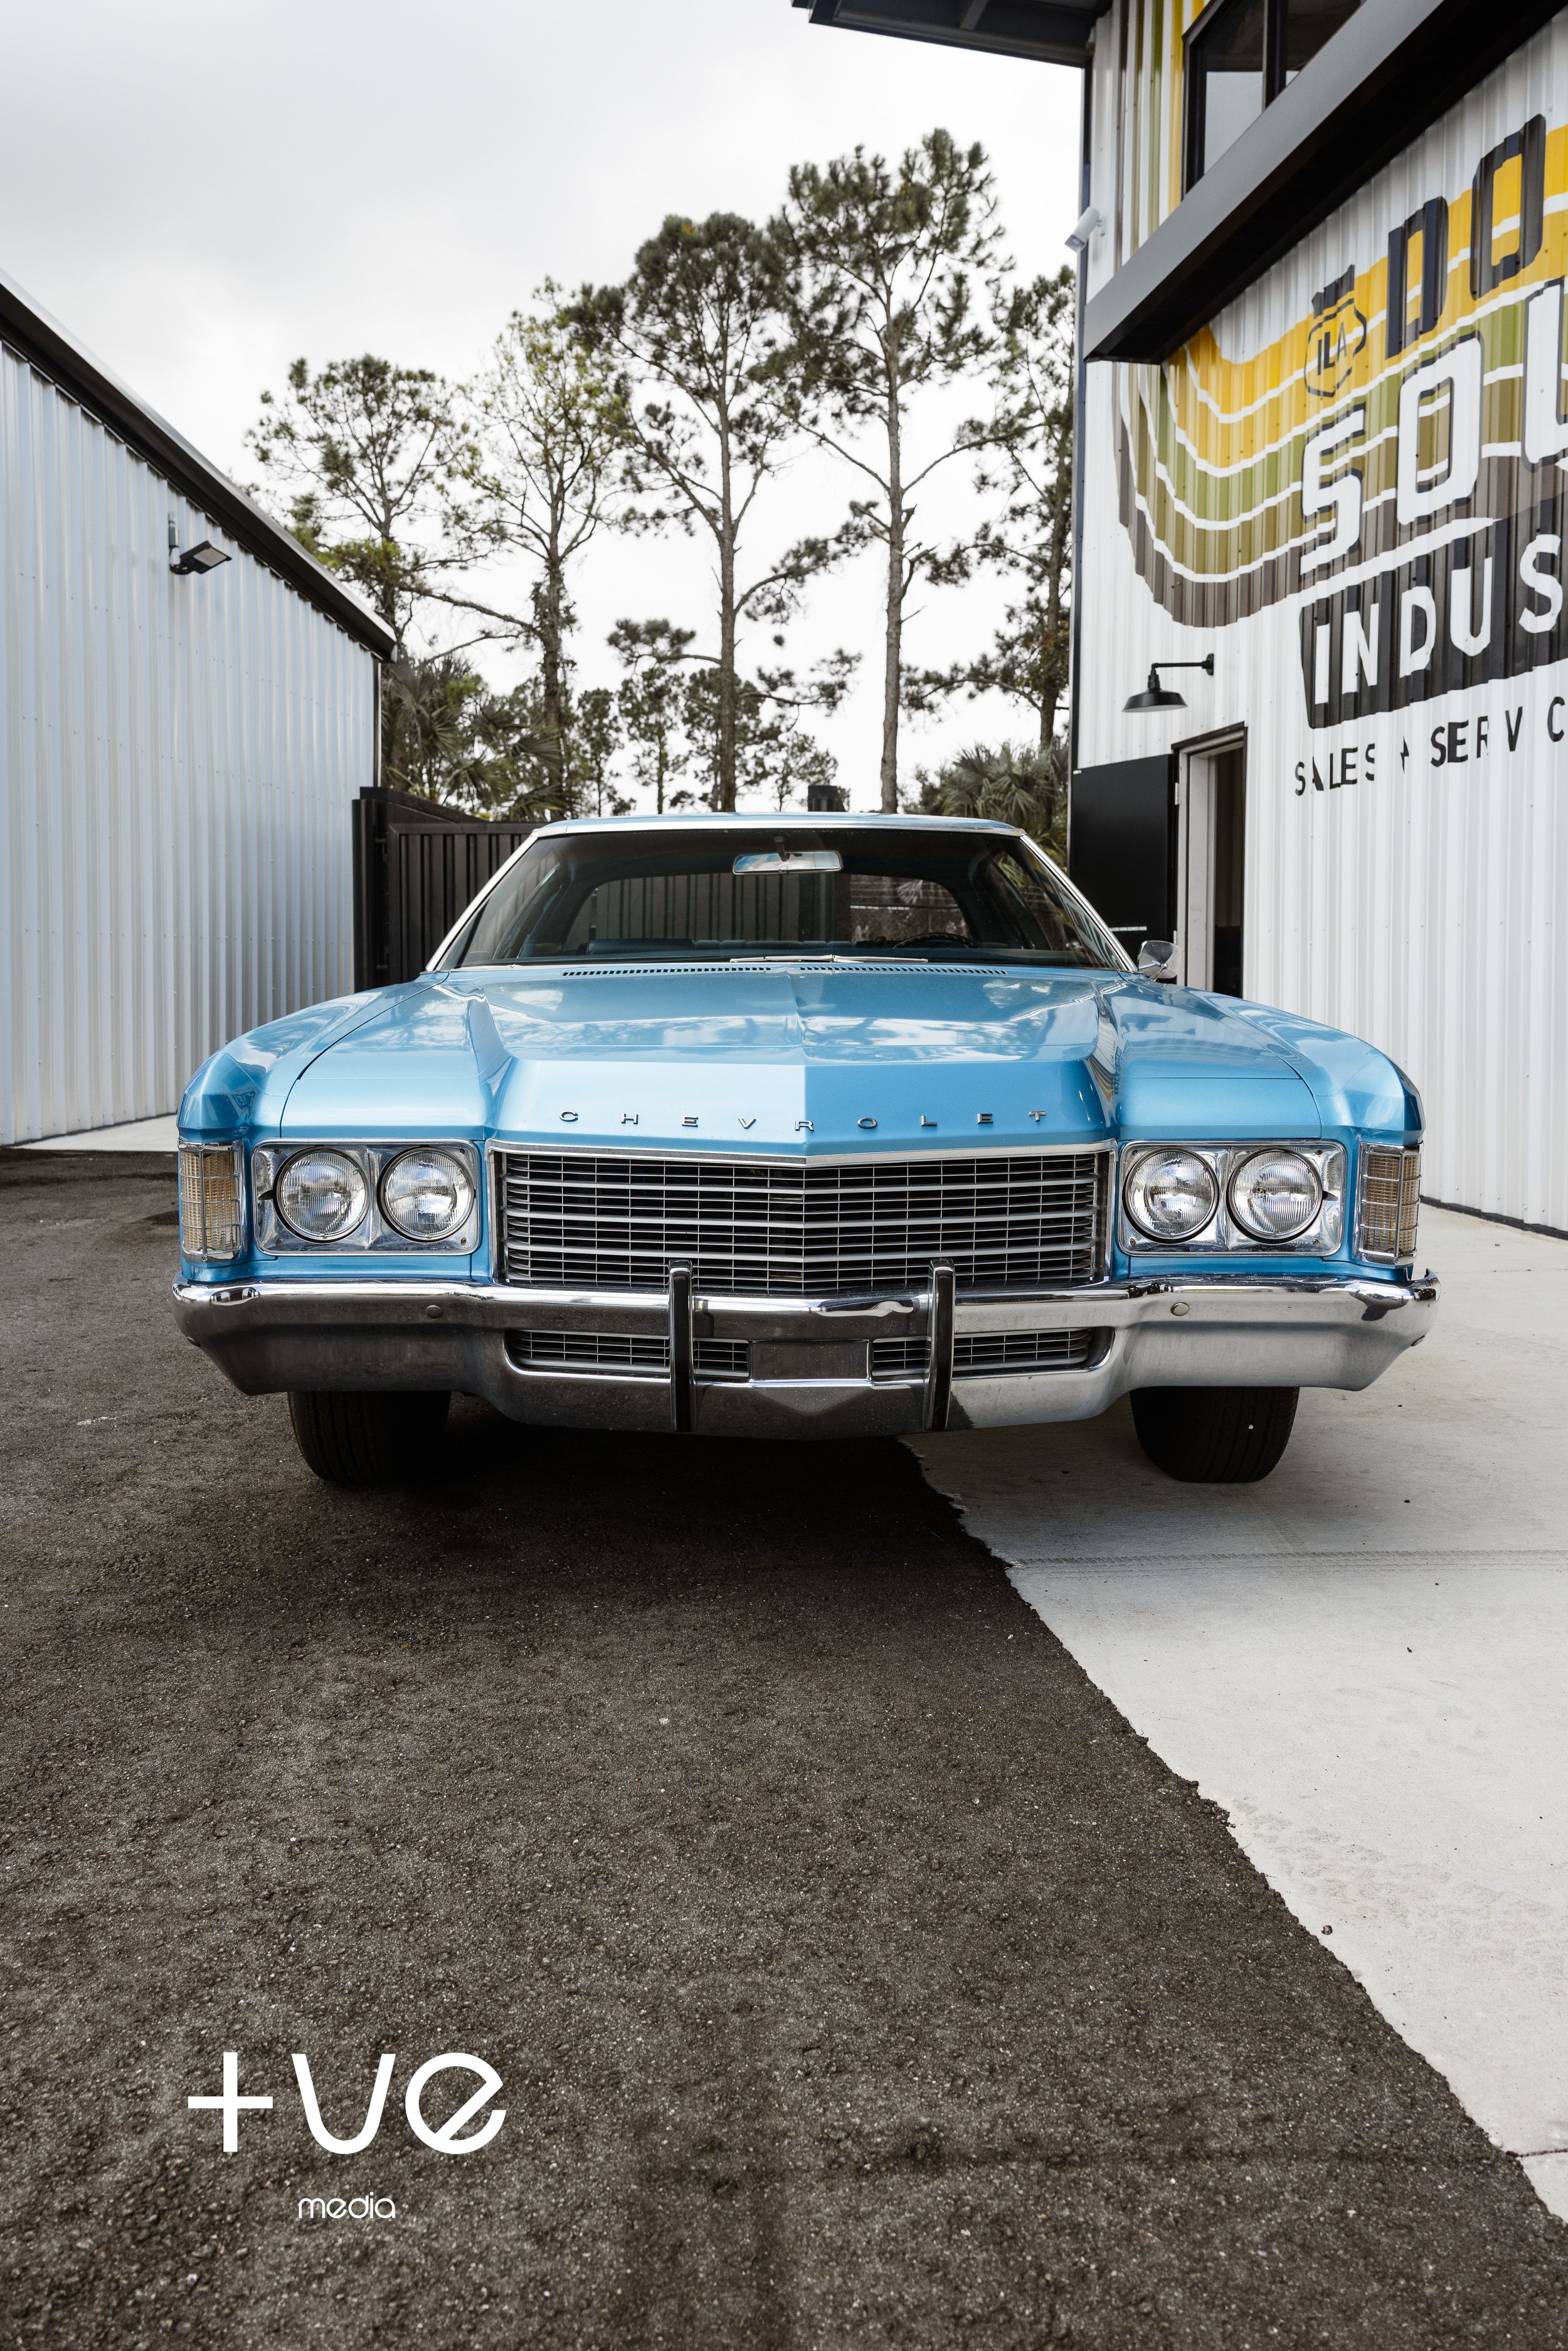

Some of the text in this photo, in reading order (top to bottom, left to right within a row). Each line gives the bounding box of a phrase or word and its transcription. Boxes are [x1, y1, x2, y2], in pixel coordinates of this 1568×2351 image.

[1315, 534, 1563, 704] INDUS
[1295, 696, 1565, 796] SALES SERVC
[559, 1110, 1046, 1132] CHEVROLET
